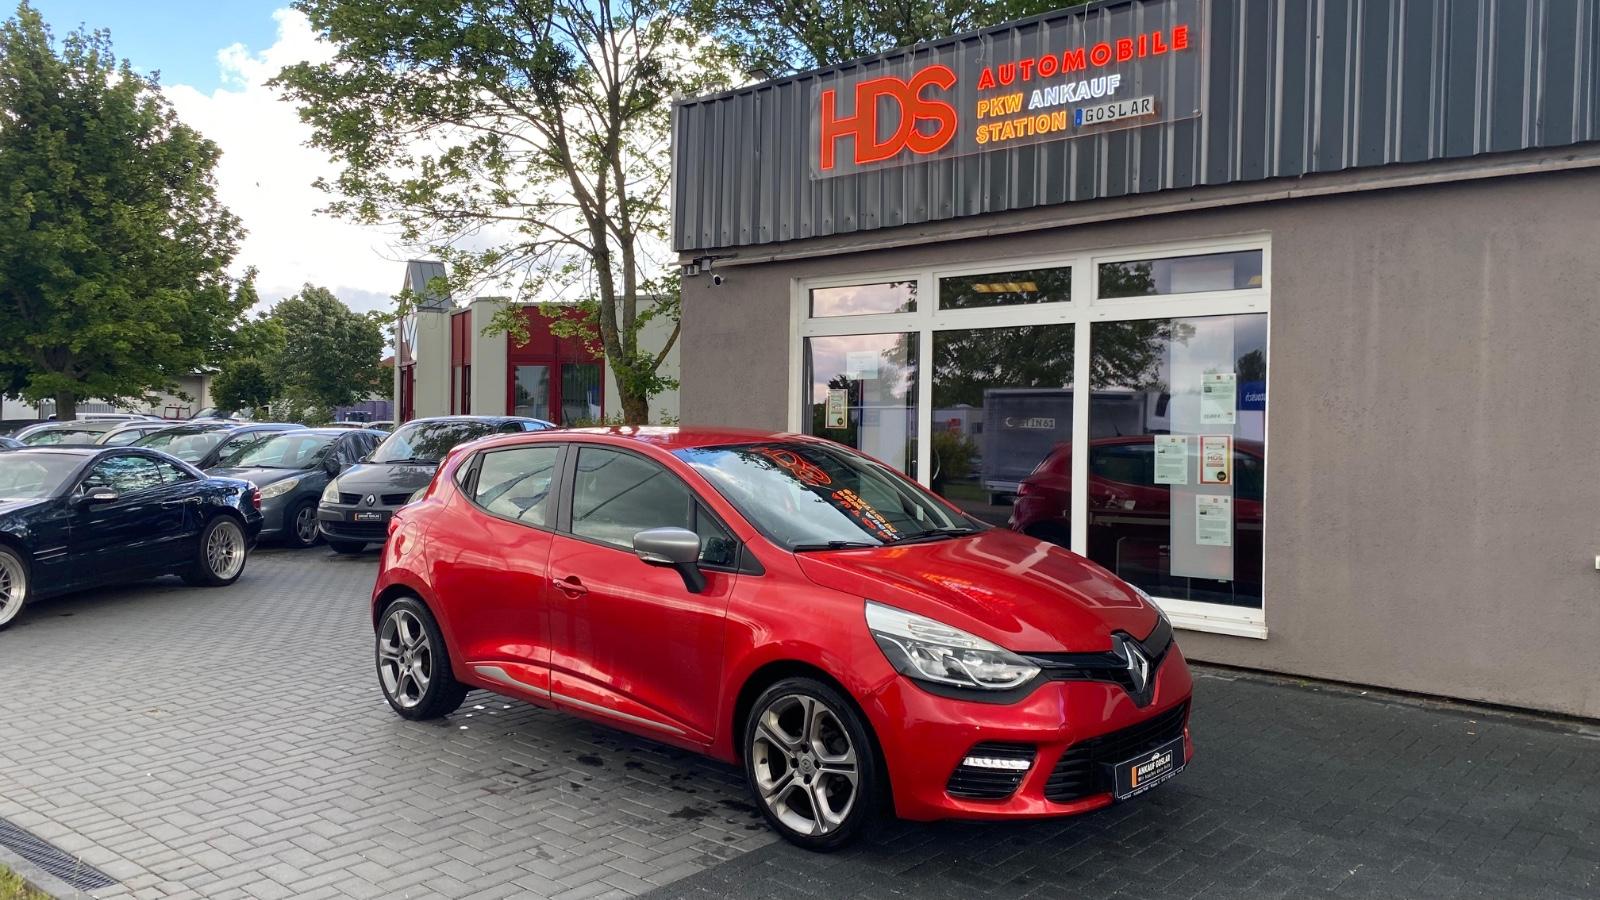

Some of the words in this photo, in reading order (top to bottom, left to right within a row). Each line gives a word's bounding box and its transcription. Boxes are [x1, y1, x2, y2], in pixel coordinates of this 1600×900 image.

[977, 24, 1189, 90] AUTOMOBILE
[821, 65, 957, 170] HDS
[975, 111, 1067, 144] STATION
[1085, 98, 1150, 122] GOSLAR
[976, 93, 1023, 119] PKW
[1028, 74, 1121, 109] ANKAUF
